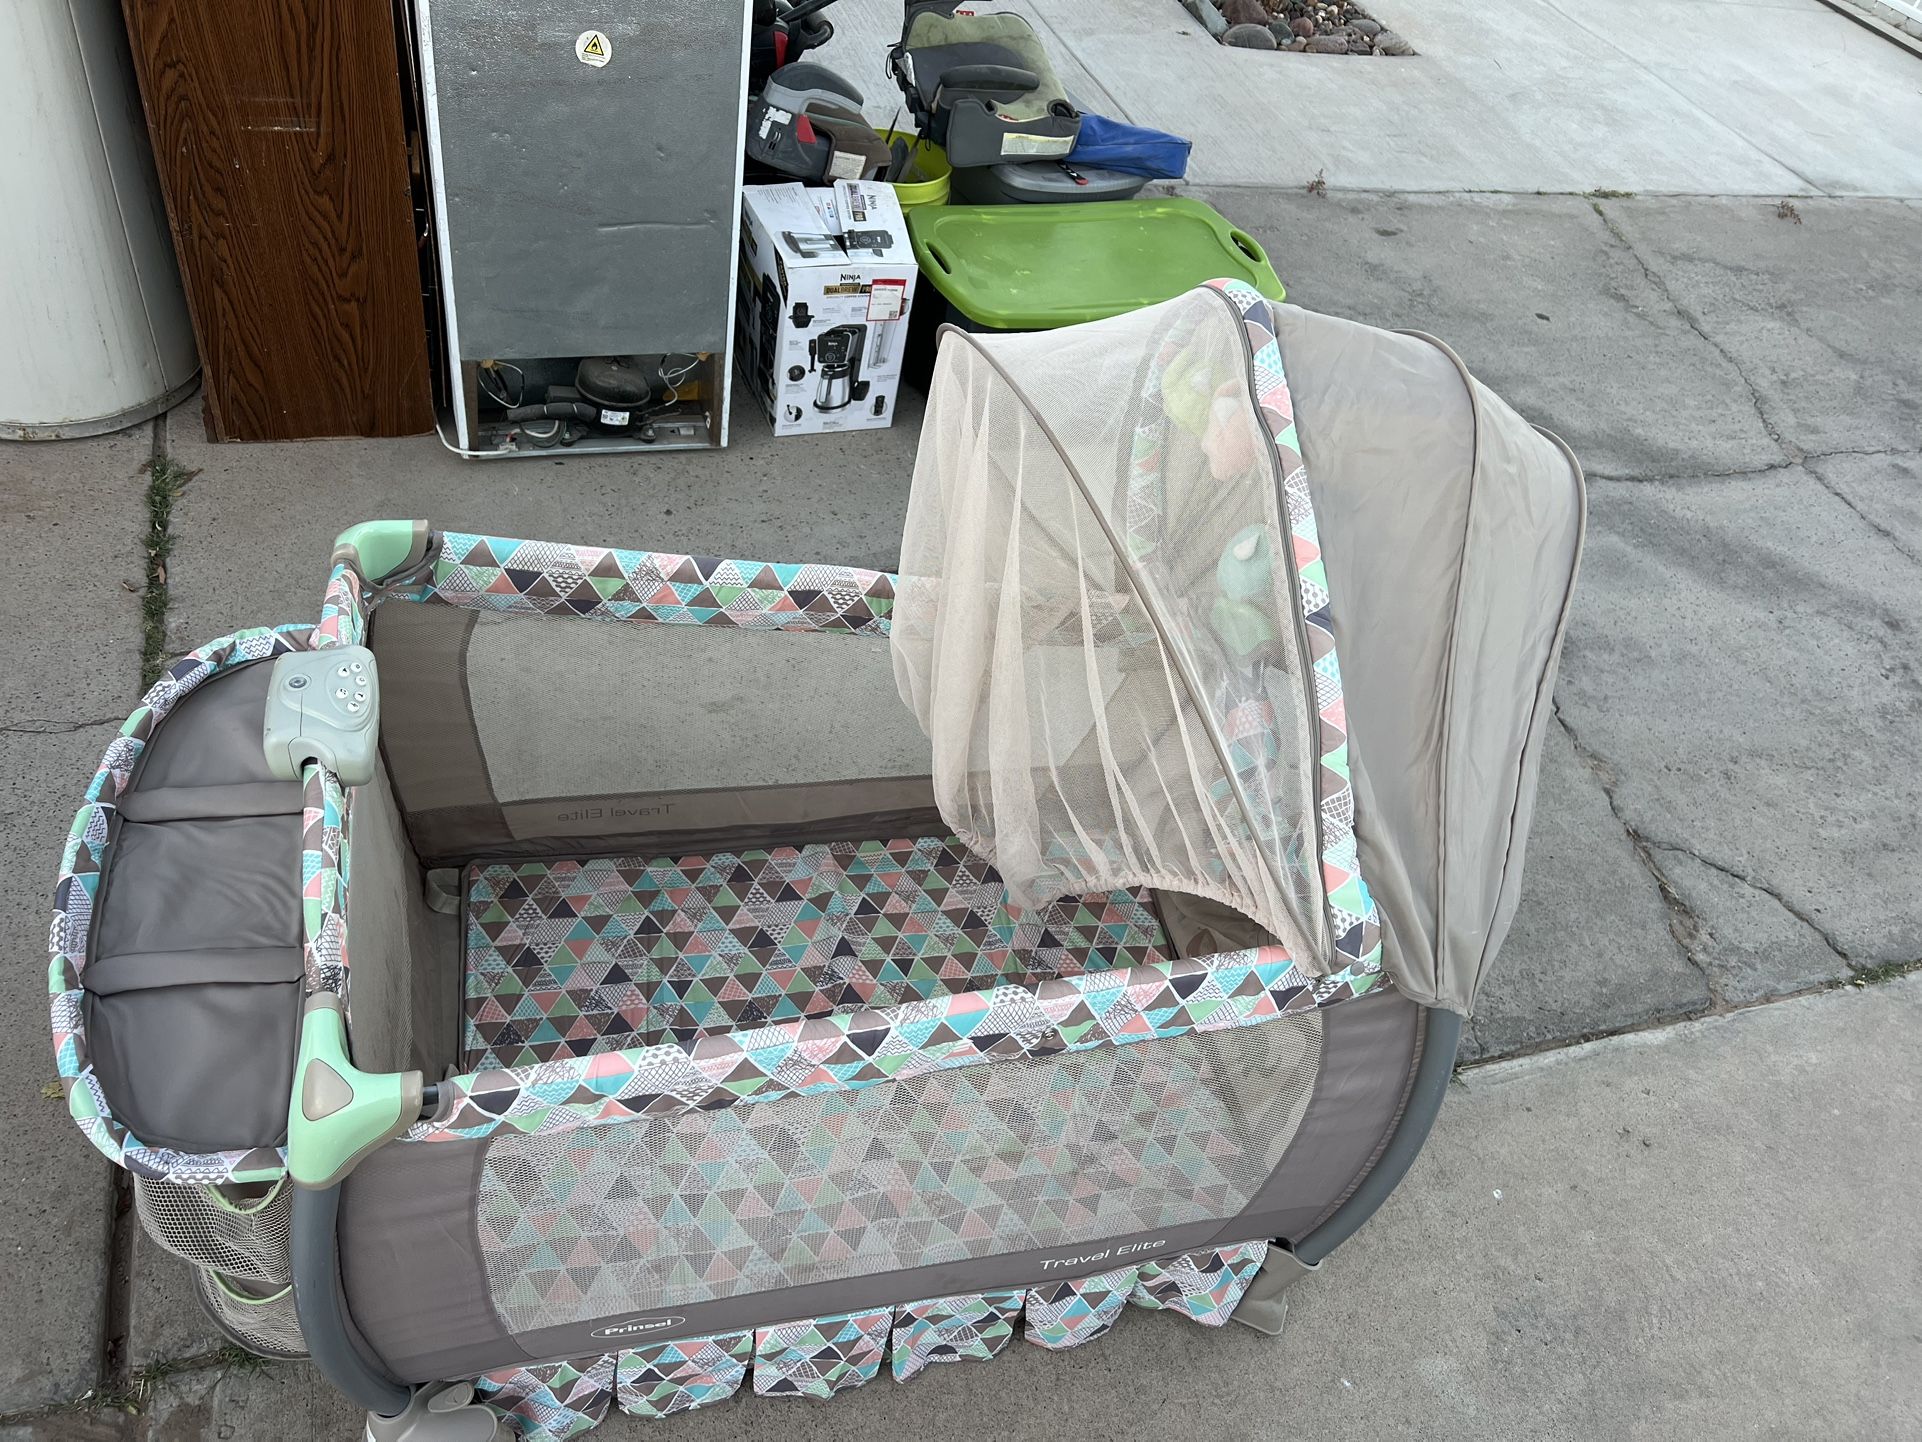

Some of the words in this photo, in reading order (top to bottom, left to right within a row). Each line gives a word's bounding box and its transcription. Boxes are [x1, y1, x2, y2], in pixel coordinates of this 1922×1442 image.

[840, 273, 861, 281] NINJA
[1040, 1249, 1110, 1270] Travel
[1116, 1240, 1166, 1256] Elite
[605, 1319, 672, 1335] Prinsel
